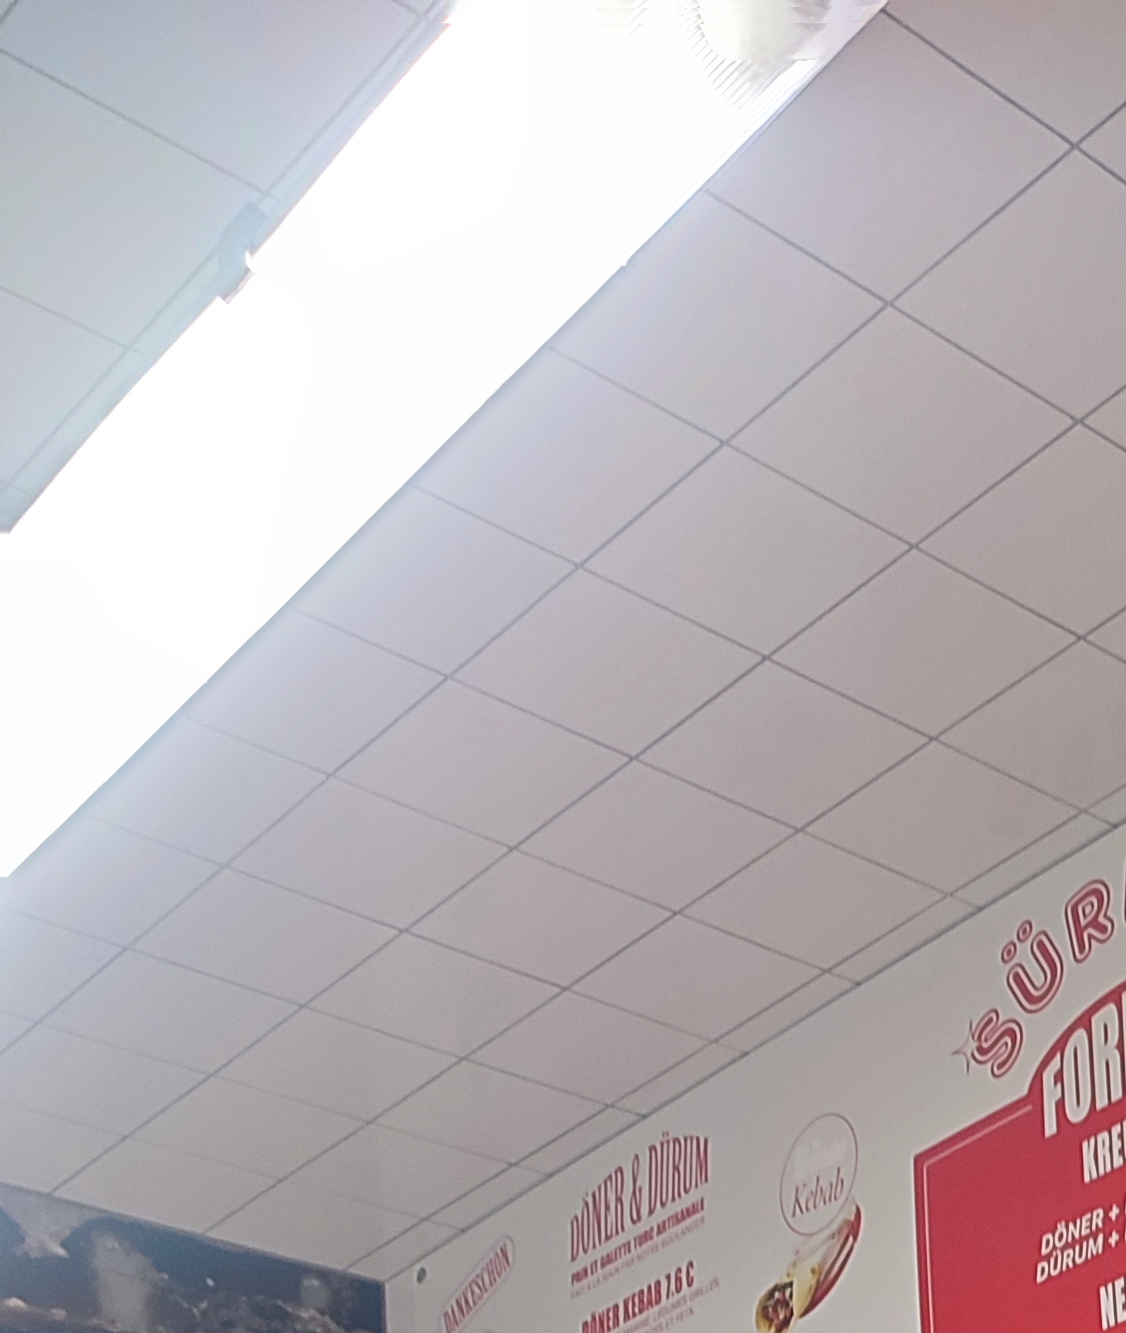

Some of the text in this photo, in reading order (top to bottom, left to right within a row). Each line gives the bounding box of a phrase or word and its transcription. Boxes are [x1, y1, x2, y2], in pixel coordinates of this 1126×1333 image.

[570, 1165, 625, 1262] DÖNER
[629, 1154, 643, 1225] &
[1041, 1208, 1104, 1255] DÖNER
[1036, 1233, 1103, 1283] DÜRUM
[623, 1279, 662, 1322] KEBAB
